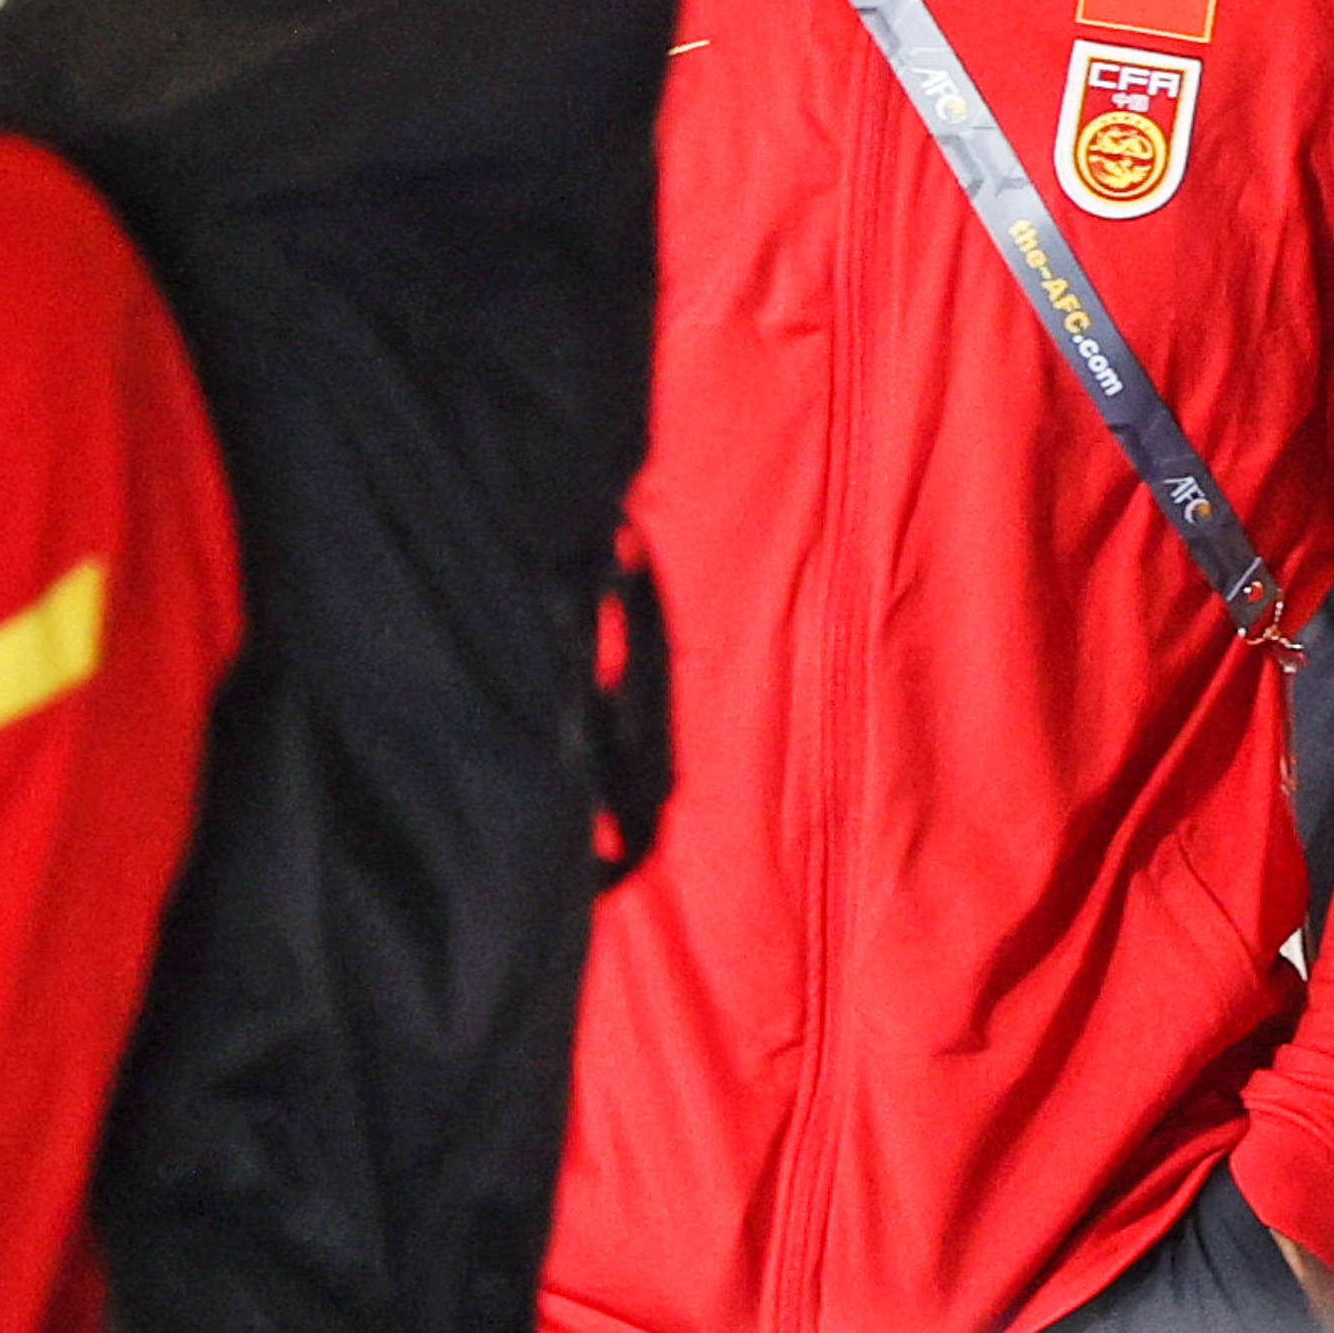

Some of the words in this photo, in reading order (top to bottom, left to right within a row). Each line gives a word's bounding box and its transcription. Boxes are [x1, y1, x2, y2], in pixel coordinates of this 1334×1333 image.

[1088, 61, 1181, 98] CFA
[1008, 219, 1123, 396] the-AFC.com
[1163, 476, 1212, 525] AFC
